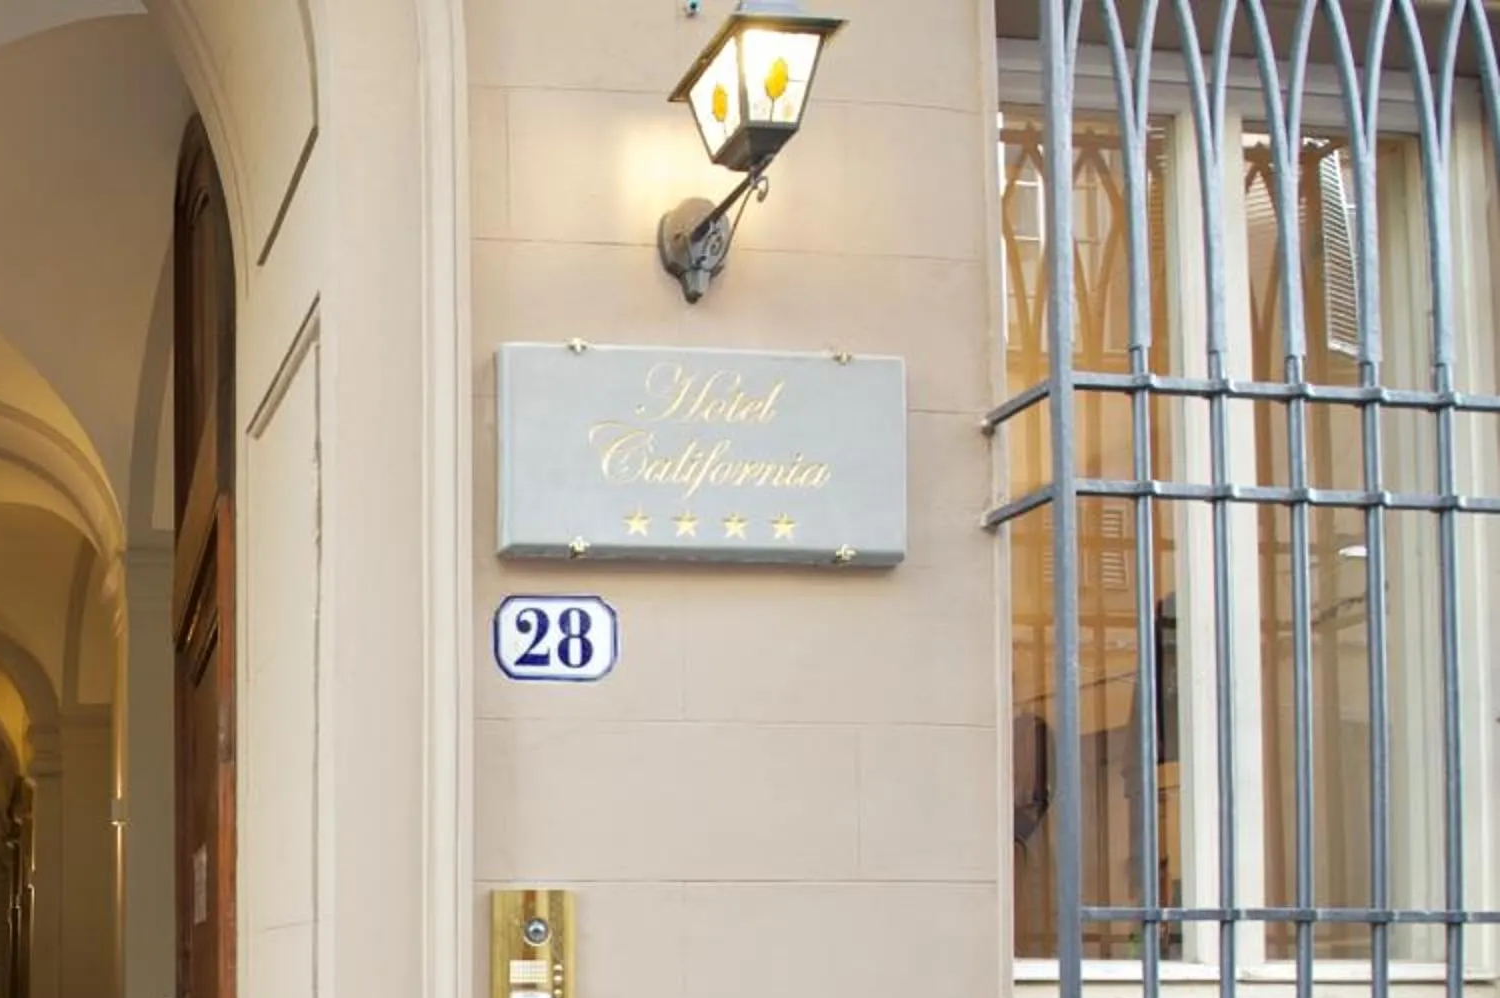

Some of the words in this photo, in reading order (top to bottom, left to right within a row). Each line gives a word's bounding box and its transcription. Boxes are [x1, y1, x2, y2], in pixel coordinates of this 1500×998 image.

[634, 361, 785, 423] Hotel
[589, 422, 832, 500] California
[514, 607, 593, 668] 28
